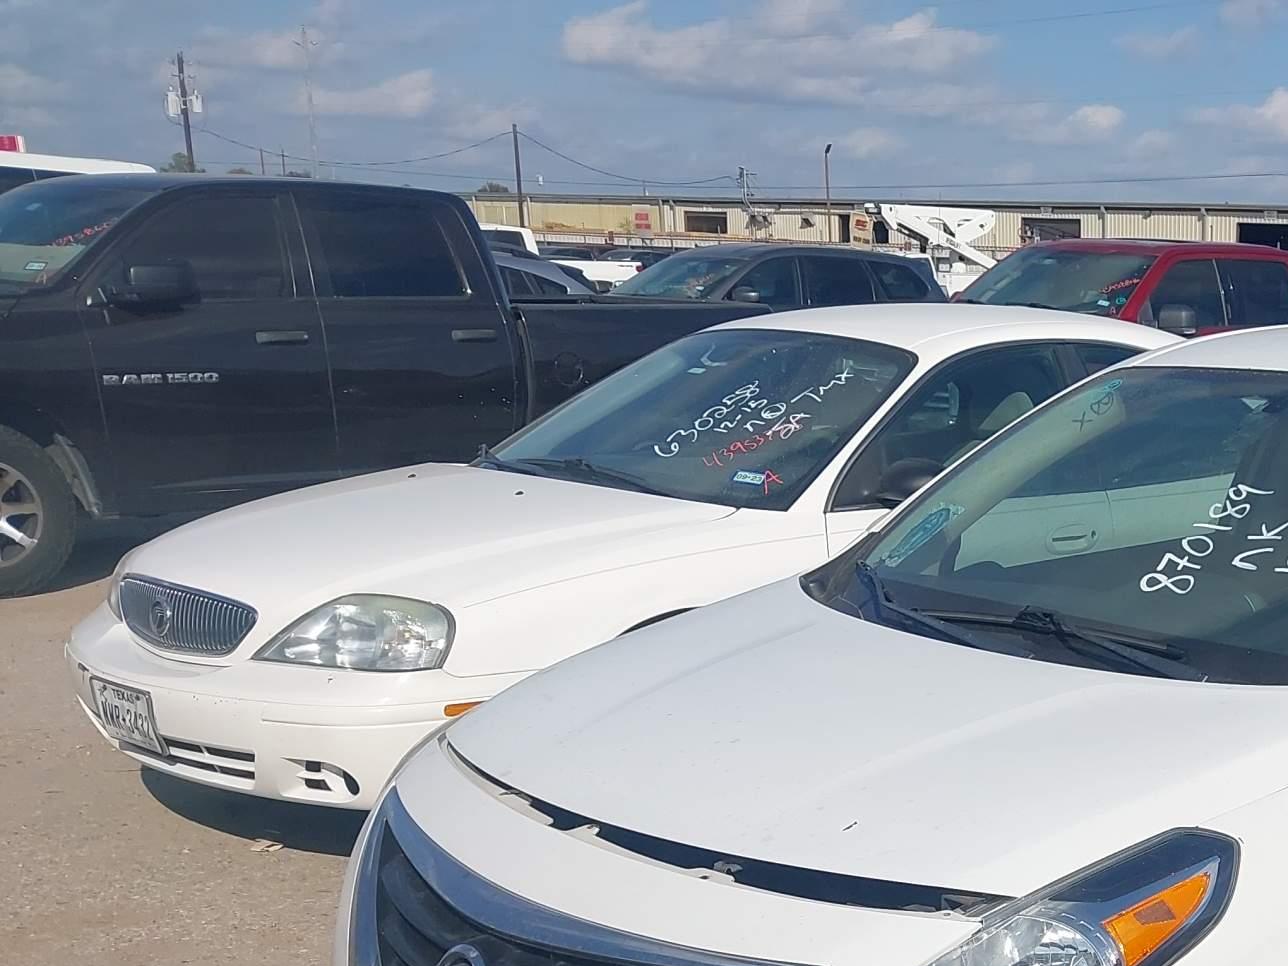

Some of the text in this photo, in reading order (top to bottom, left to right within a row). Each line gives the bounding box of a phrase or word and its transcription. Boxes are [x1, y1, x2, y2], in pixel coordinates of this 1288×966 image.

[102, 372, 220, 386] RAM 1500
[1139, 483, 1275, 595] 870189
[111, 687, 135, 705] TEXAS
